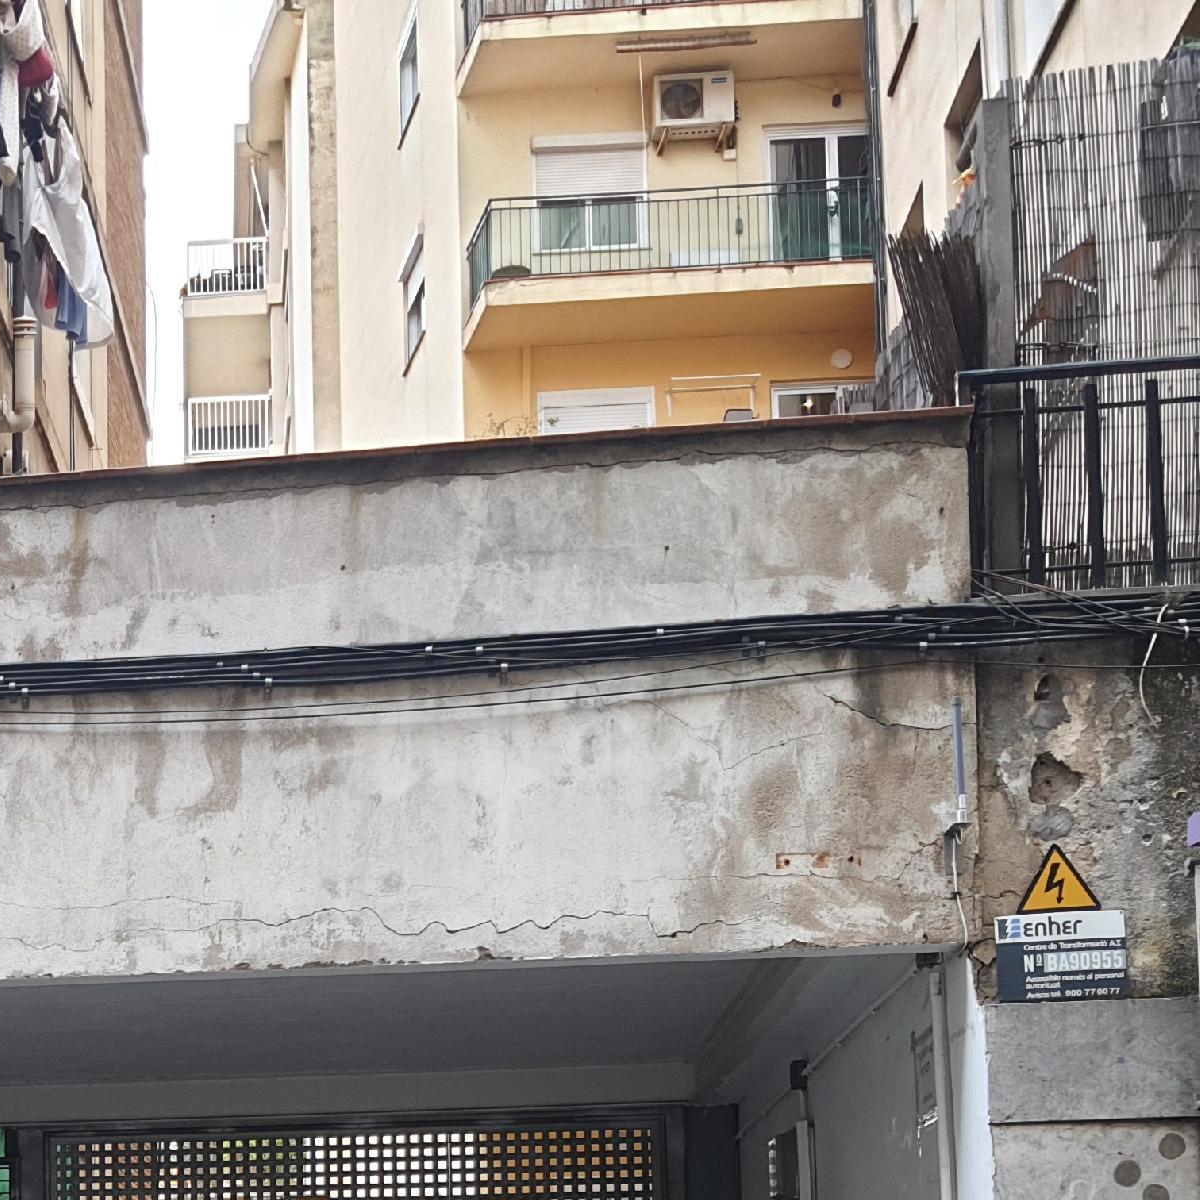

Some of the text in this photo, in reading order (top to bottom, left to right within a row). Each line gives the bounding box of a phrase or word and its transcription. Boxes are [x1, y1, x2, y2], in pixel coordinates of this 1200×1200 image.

[1023, 916, 1083, 937] enher
[1048, 942, 1058, 950] de
[1047, 950, 1124, 972] BA90955
[1084, 988, 1095, 996] 77
[1108, 987, 1121, 995] 77
